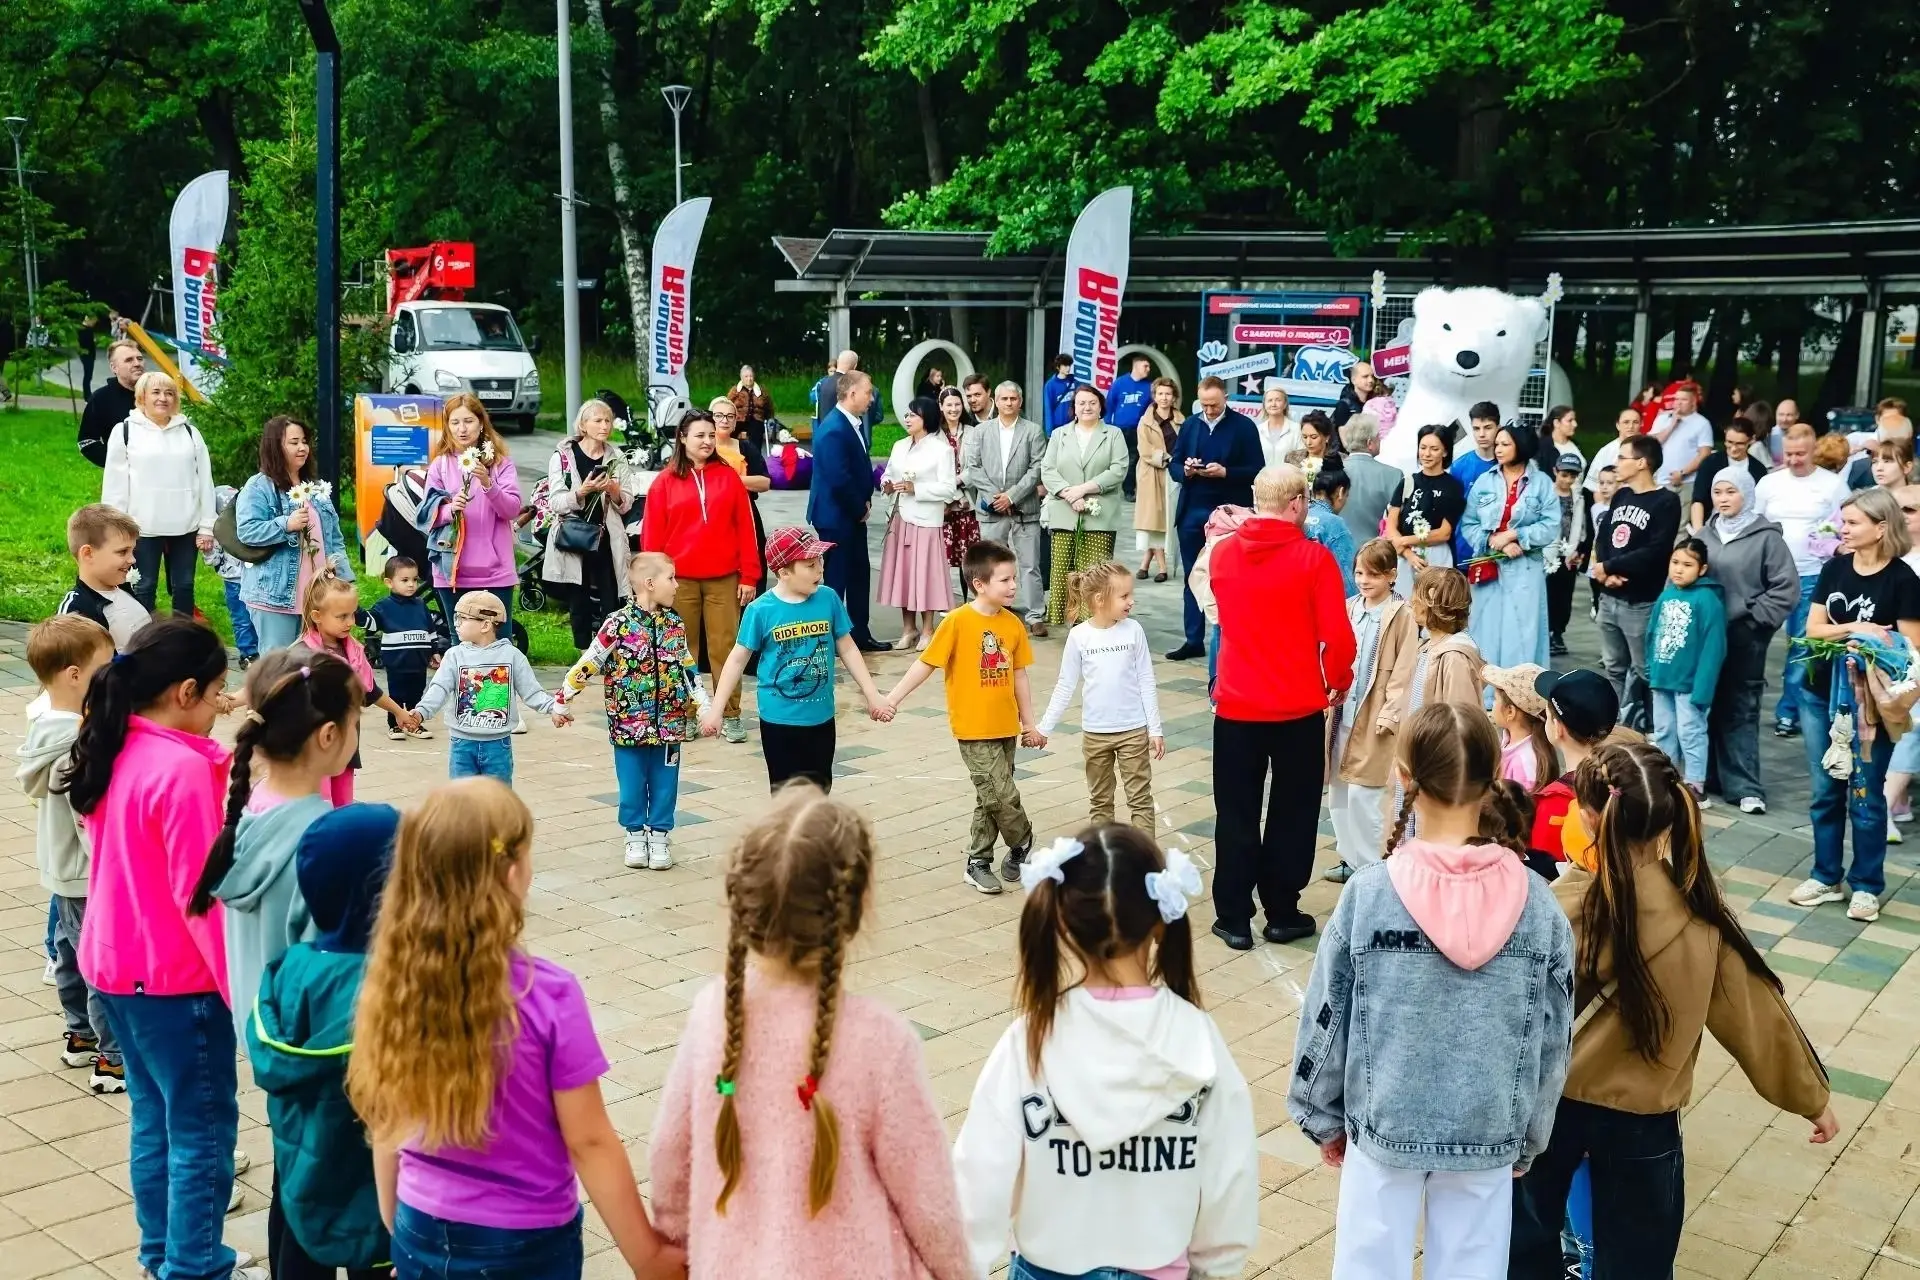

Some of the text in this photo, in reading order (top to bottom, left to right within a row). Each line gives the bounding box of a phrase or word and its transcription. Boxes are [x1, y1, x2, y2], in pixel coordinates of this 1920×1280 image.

[1078, 267, 1119, 390] ВАРДИЯ
[1242, 330, 1249, 338] С
[1249, 329, 1286, 339] ЗАБОТОЙ
[1295, 331, 1326, 339] ЛЮДЯХ
[403, 633, 427, 641] FUTURE
[774, 627, 798, 641] RIDE
[800, 622, 829, 635] MORE
[1086, 643, 1129, 656] TRUSSARDI
[980, 668, 1010, 680] BEST
[980, 678, 1010, 688] HIKER
[458, 709, 504, 729] AVENGERS
[1049, 1135, 1198, 1177] TO SHINE
